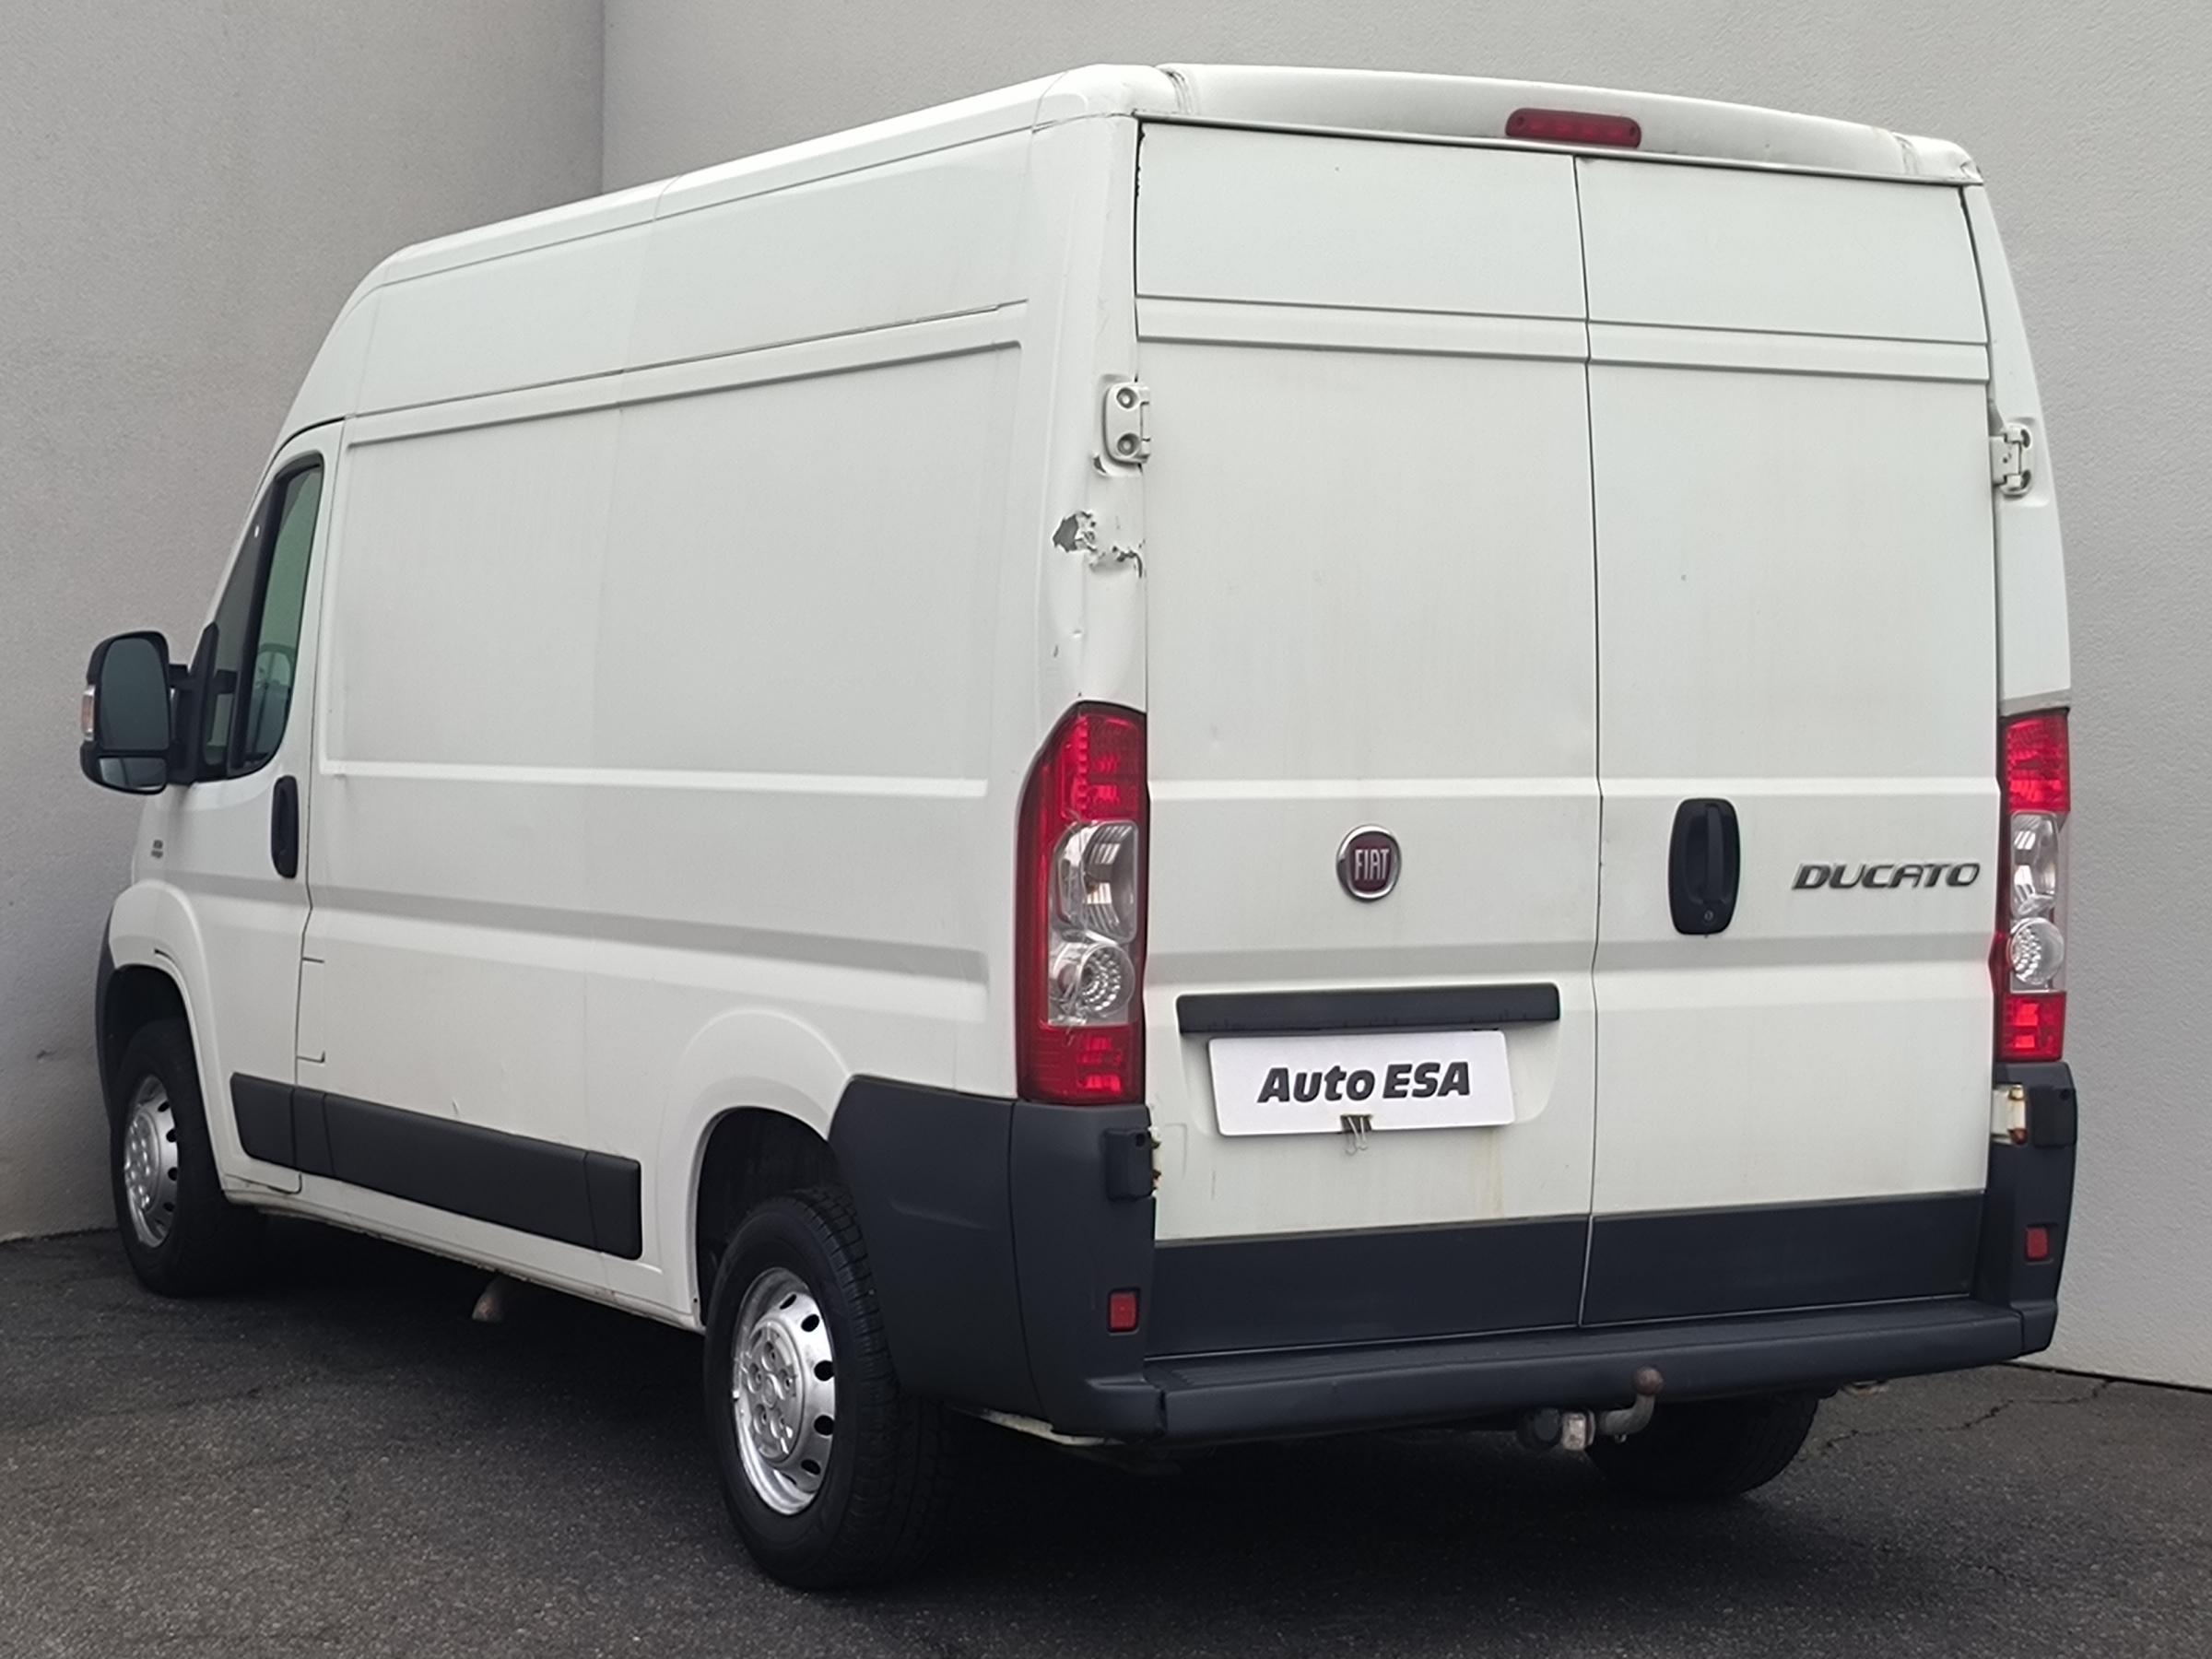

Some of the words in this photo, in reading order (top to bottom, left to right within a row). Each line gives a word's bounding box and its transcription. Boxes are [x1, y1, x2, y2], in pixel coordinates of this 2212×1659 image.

[1354, 848, 1390, 881] FIAT
[1792, 863, 1981, 890] DUCATO
[1256, 1065, 1375, 1104] Auto
[1382, 1061, 1470, 1099] ESA
